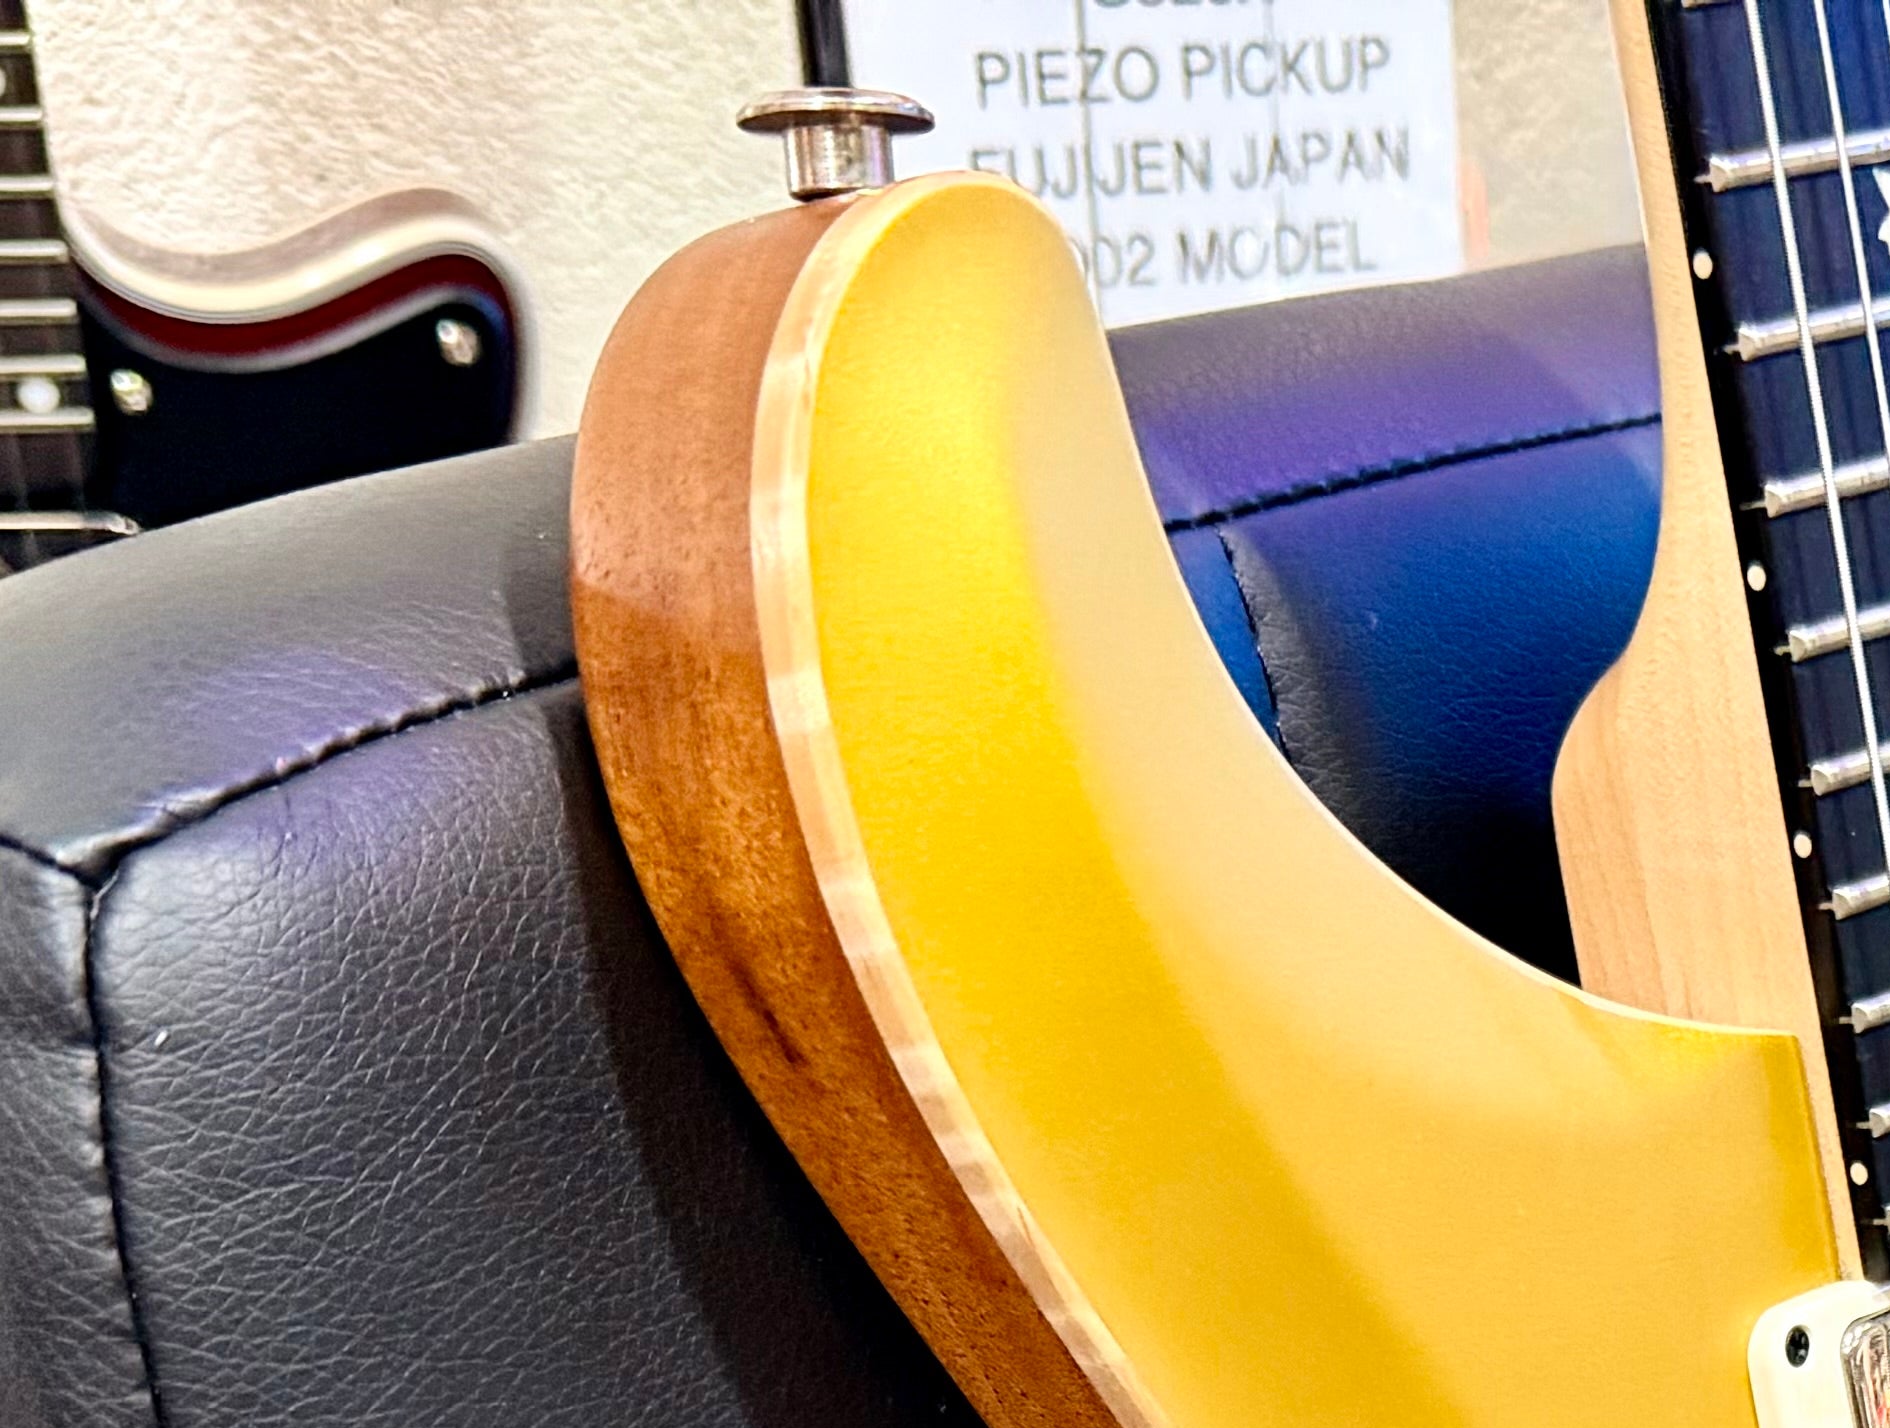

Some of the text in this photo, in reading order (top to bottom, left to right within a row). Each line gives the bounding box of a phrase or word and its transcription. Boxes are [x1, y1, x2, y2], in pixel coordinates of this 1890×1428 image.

[974, 37, 1390, 110] PIEZO PICKUP
[1230, 129, 1410, 190] JAPAN
[1176, 219, 1378, 285] MODEL
